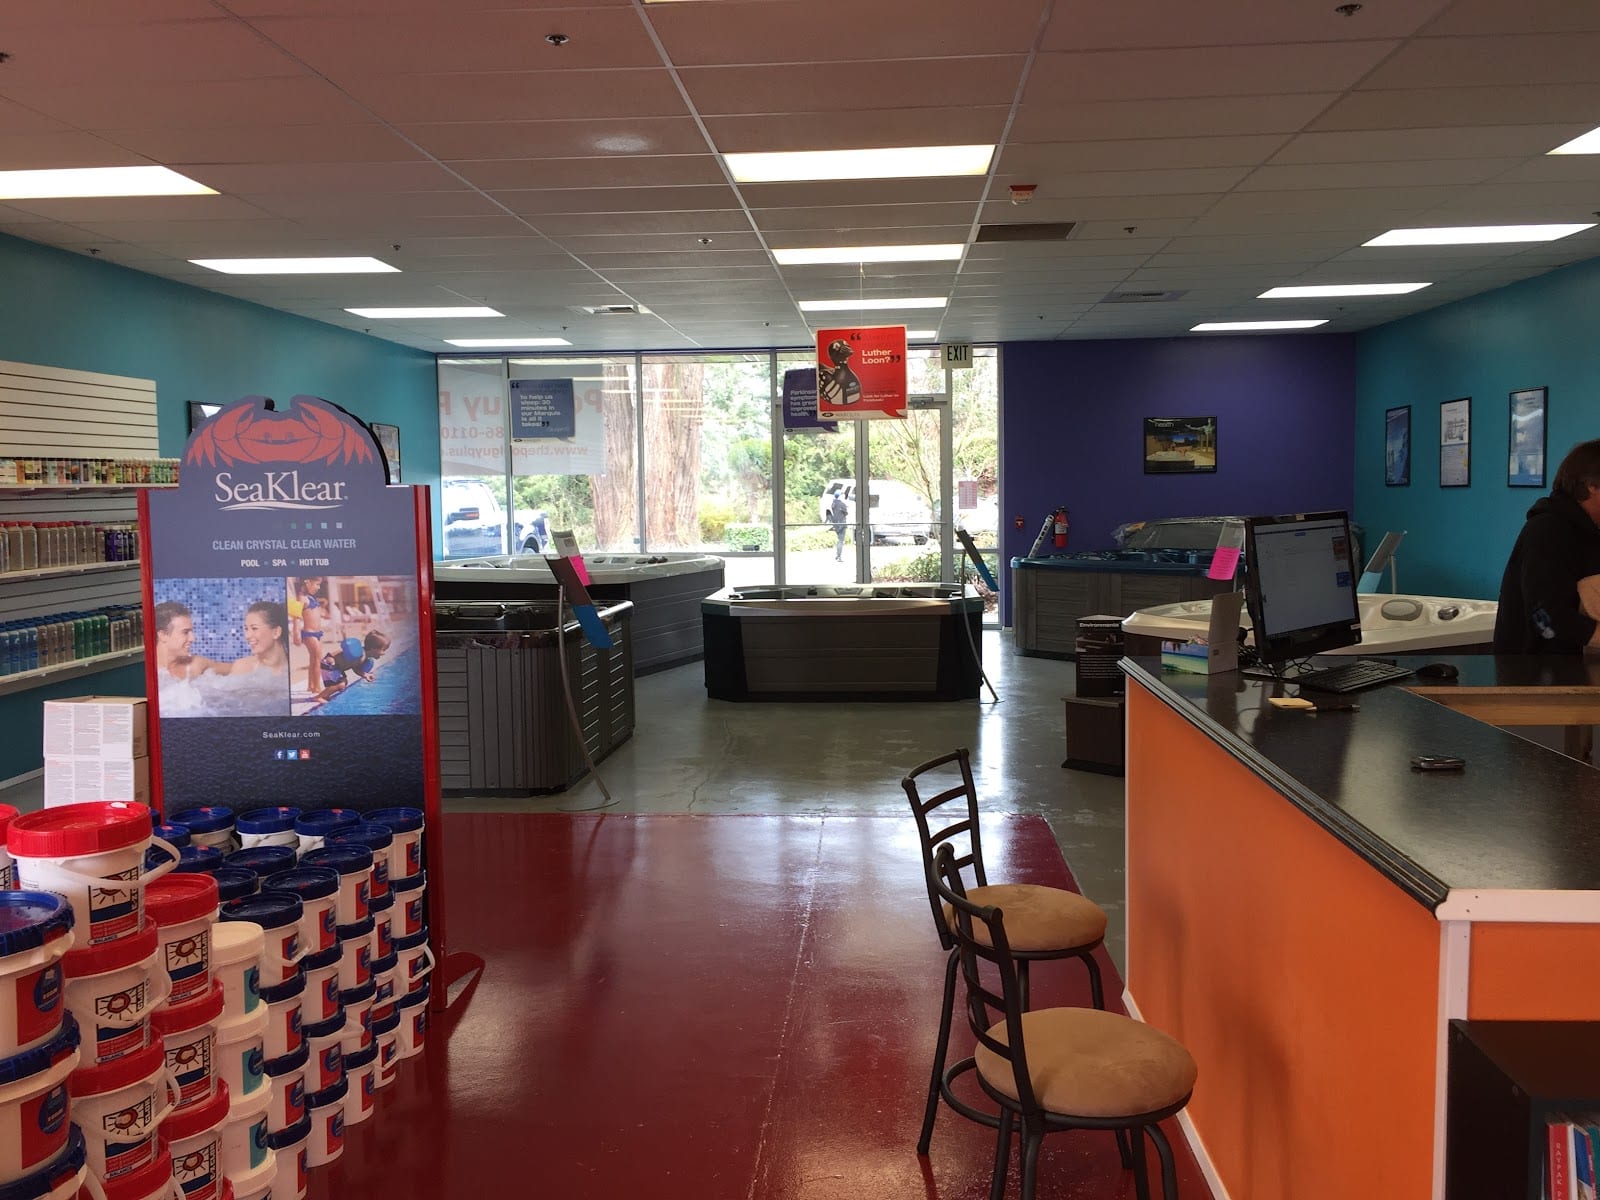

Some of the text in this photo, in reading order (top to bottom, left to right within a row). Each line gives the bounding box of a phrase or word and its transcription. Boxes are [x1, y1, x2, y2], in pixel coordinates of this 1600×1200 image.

[862, 349, 892, 357] Luther
[947, 345, 968, 361] EXIT
[862, 356, 890, 364] Loon?
[215, 470, 345, 502] SeaKlear
[212, 538, 356, 550] CLEAN CRYSTAL CLEAR WATER
